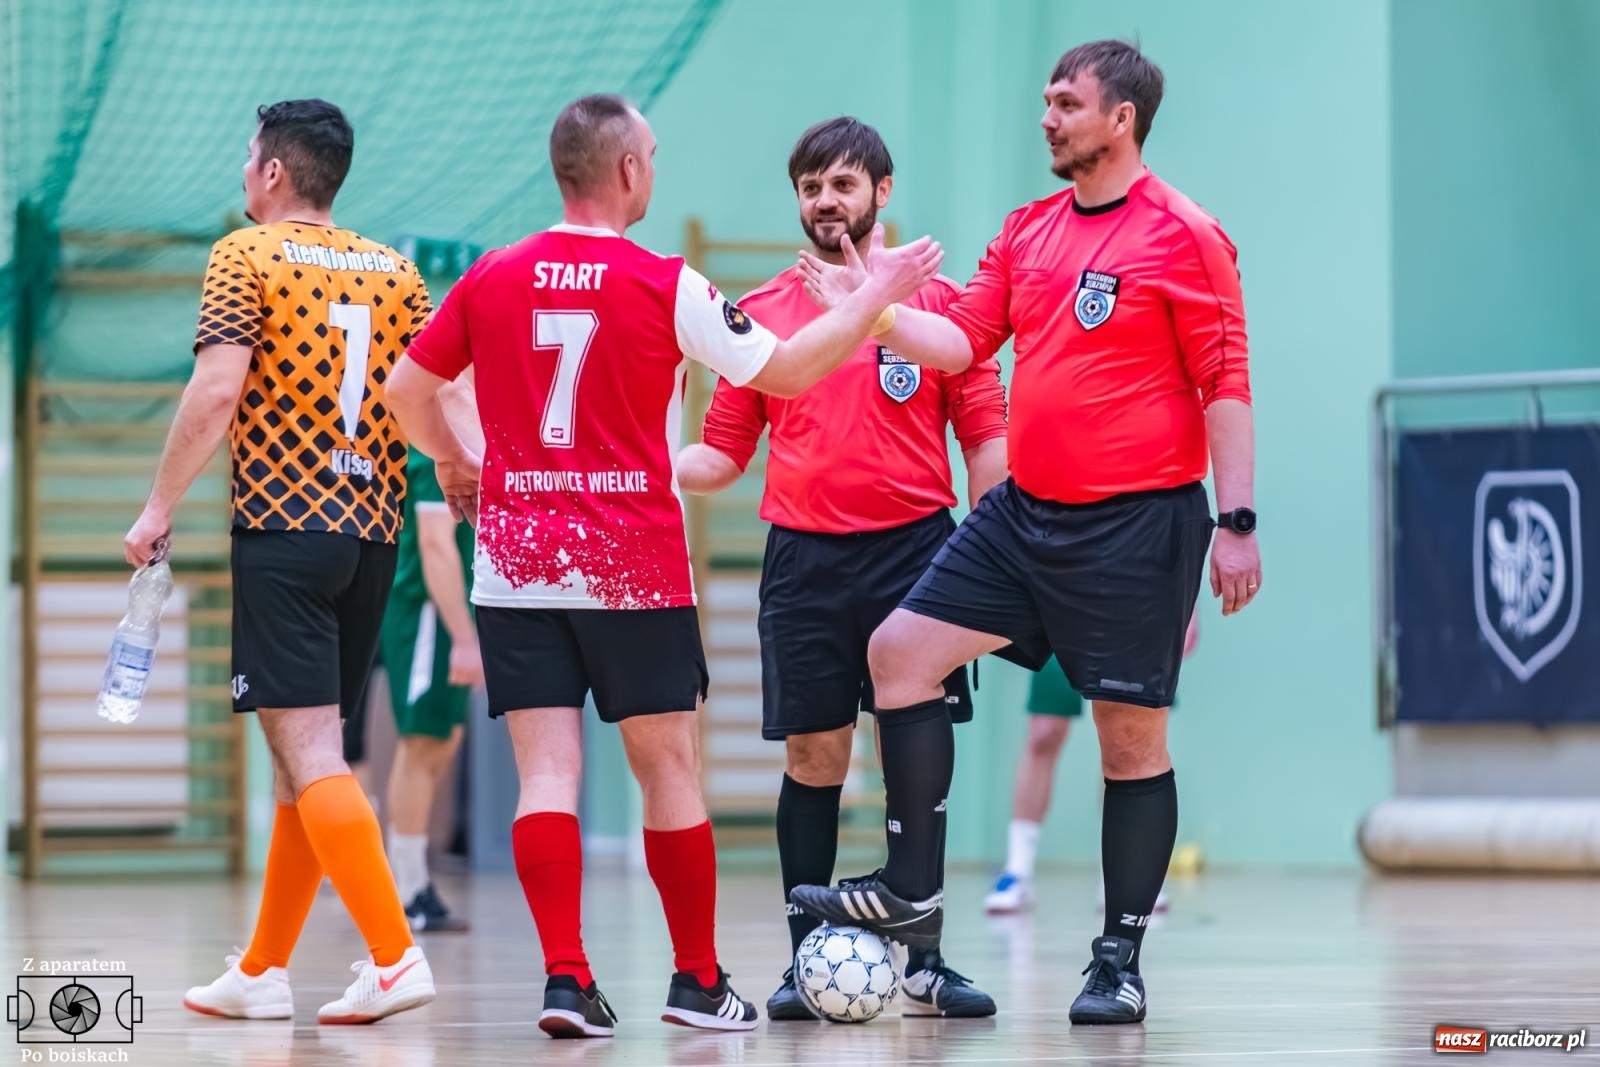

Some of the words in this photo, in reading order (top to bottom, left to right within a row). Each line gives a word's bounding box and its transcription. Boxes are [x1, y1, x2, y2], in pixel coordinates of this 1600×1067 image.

[533, 260, 608, 290] START
[328, 300, 372, 442] 7
[532, 309, 600, 449] 7
[504, 470, 584, 493] PIETROWICE
[587, 471, 648, 494] WIELKIE
